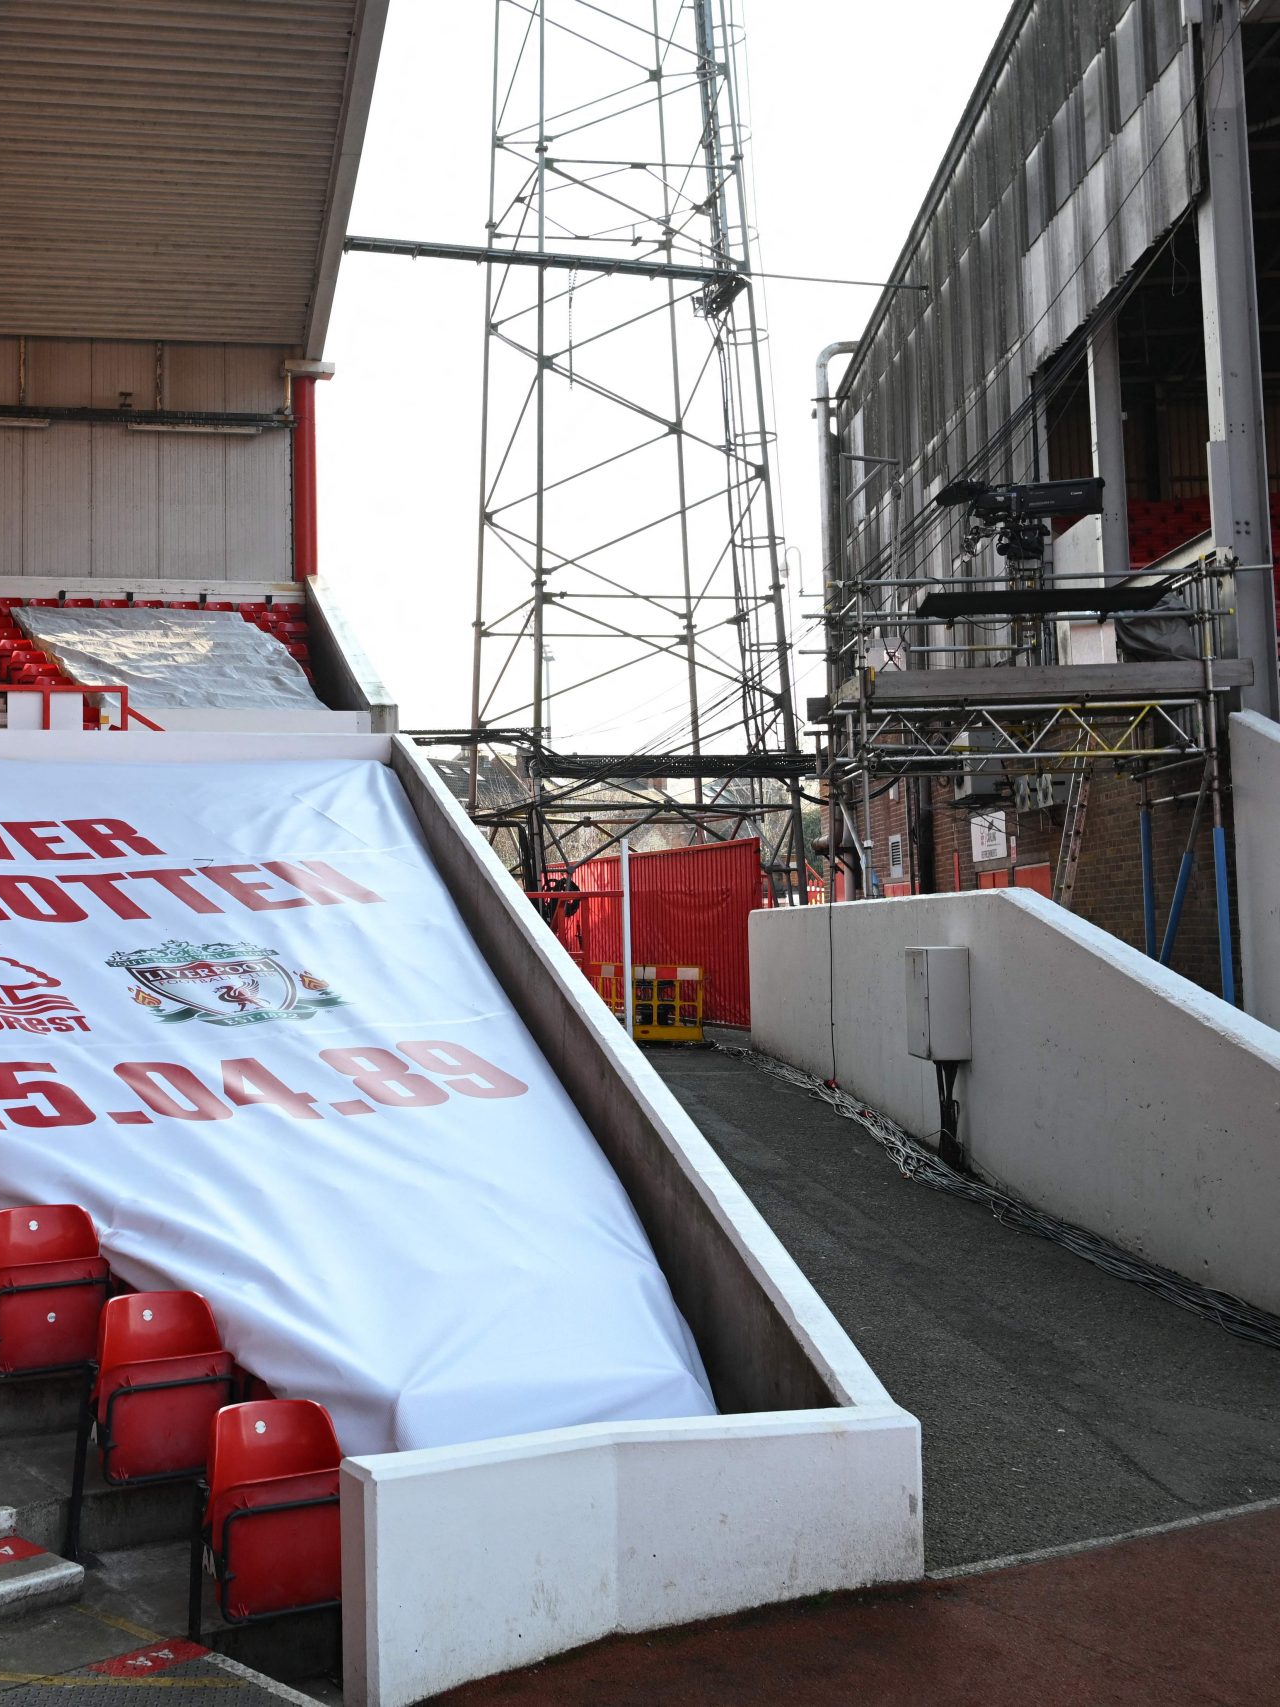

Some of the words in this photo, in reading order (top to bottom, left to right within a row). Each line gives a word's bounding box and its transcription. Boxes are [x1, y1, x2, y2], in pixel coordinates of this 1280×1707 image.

[144, 962, 275, 982] LIVERPOOL
[158, 972, 233, 986] FOOTBALL
[201, 1544, 217, 1579] AA
